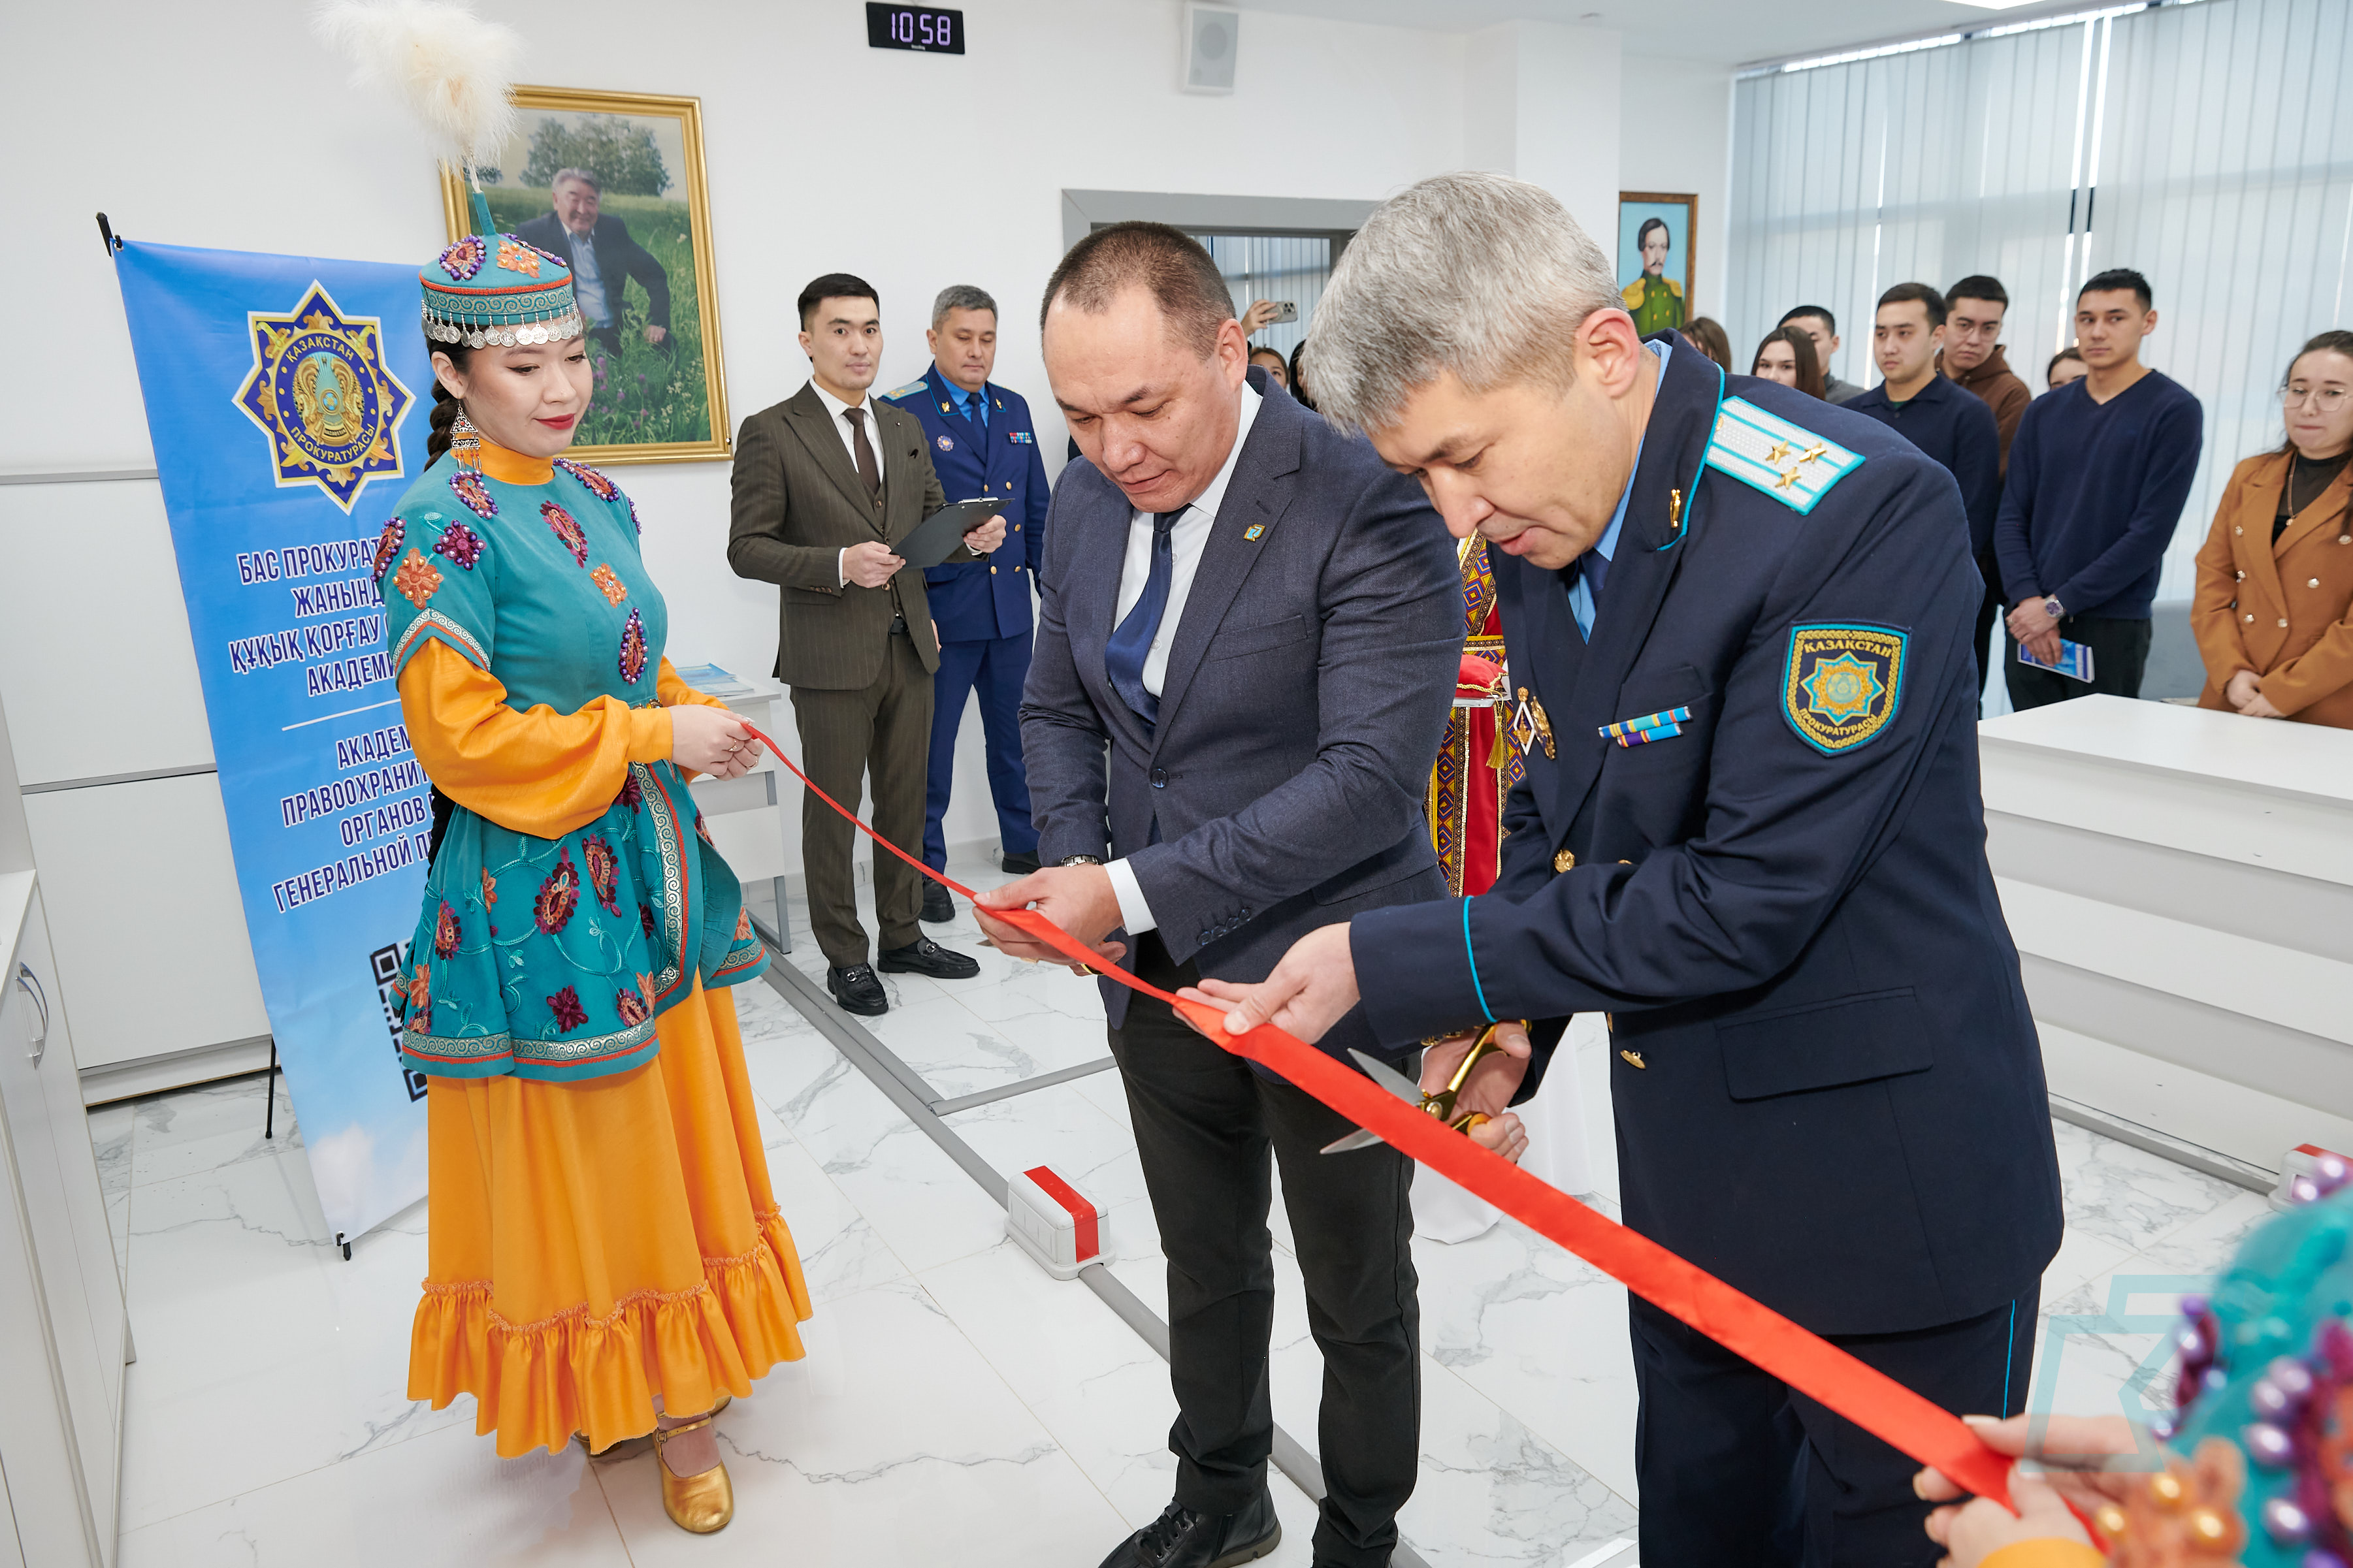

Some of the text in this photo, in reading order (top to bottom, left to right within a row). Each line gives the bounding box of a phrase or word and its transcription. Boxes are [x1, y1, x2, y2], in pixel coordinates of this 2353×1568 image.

[291, 423, 376, 462] ПРОКУРАТУРАСЫ
[237, 551, 280, 584] БАС
[229, 630, 305, 674] ҚҰҚЫҚ
[304, 615, 380, 658] ҚОРҒАУ
[1799, 707, 1877, 736] ПРОКУРАТУРАСЫ
[340, 797, 428, 847] ОРГАНОВ
[272, 834, 414, 913] ГЕНЕРАЛЬНОЙ
